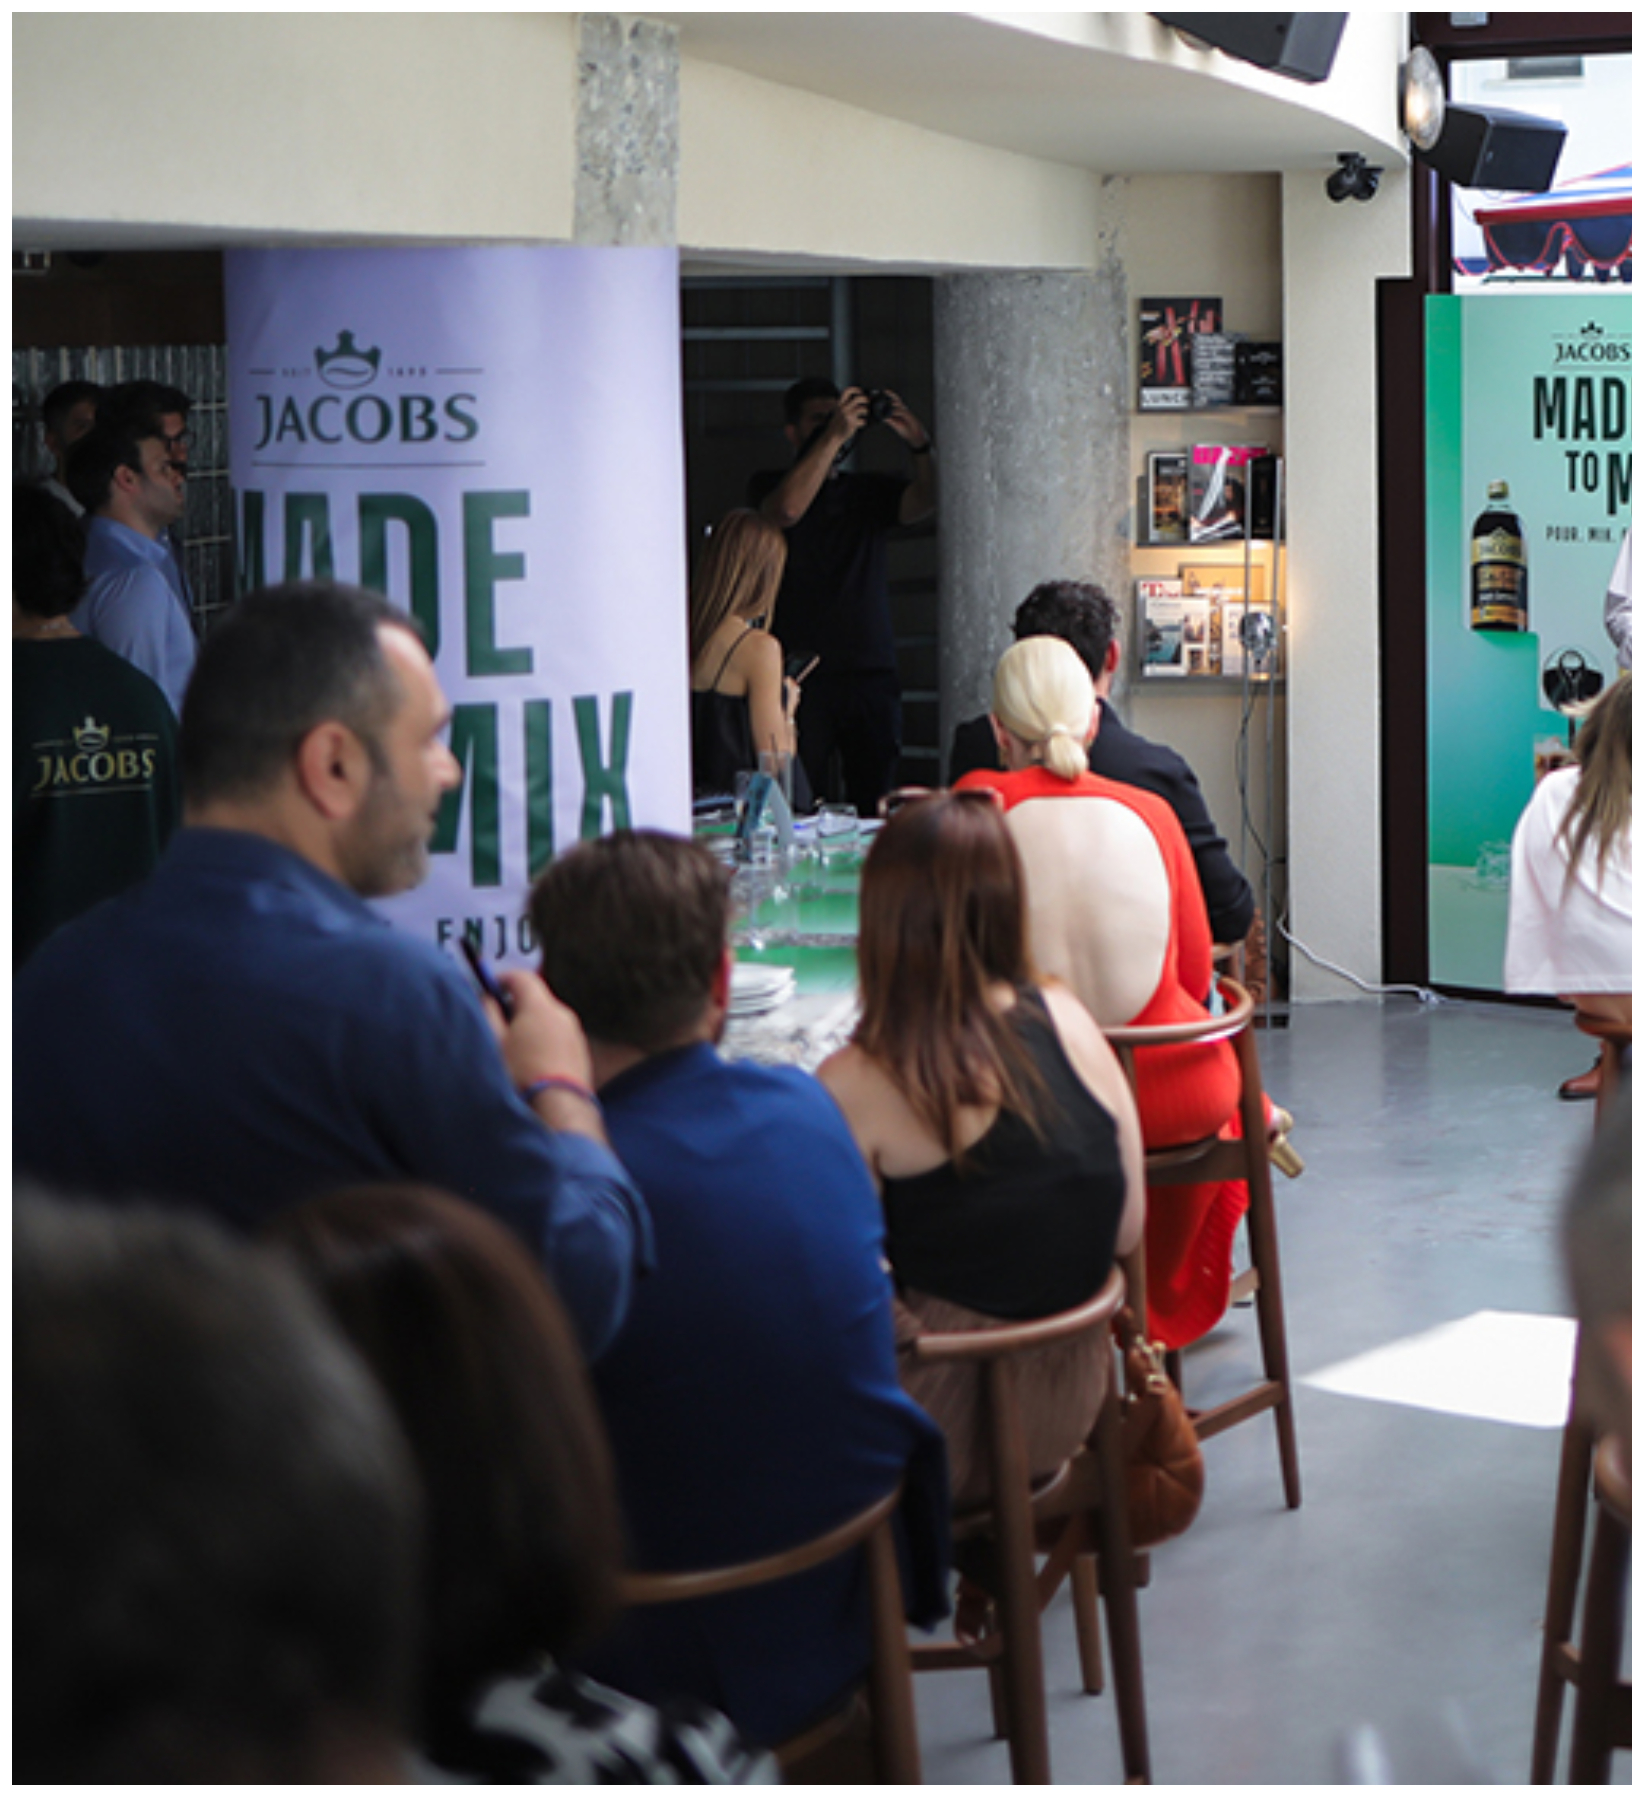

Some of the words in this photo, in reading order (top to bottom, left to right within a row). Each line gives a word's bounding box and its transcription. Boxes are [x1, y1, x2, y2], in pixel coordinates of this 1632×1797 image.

[1555, 343, 1631, 362] JACOBS
[254, 393, 479, 451] JACOBS
[1565, 450, 1598, 492] TO
[32, 748, 157, 791] JACOBS
